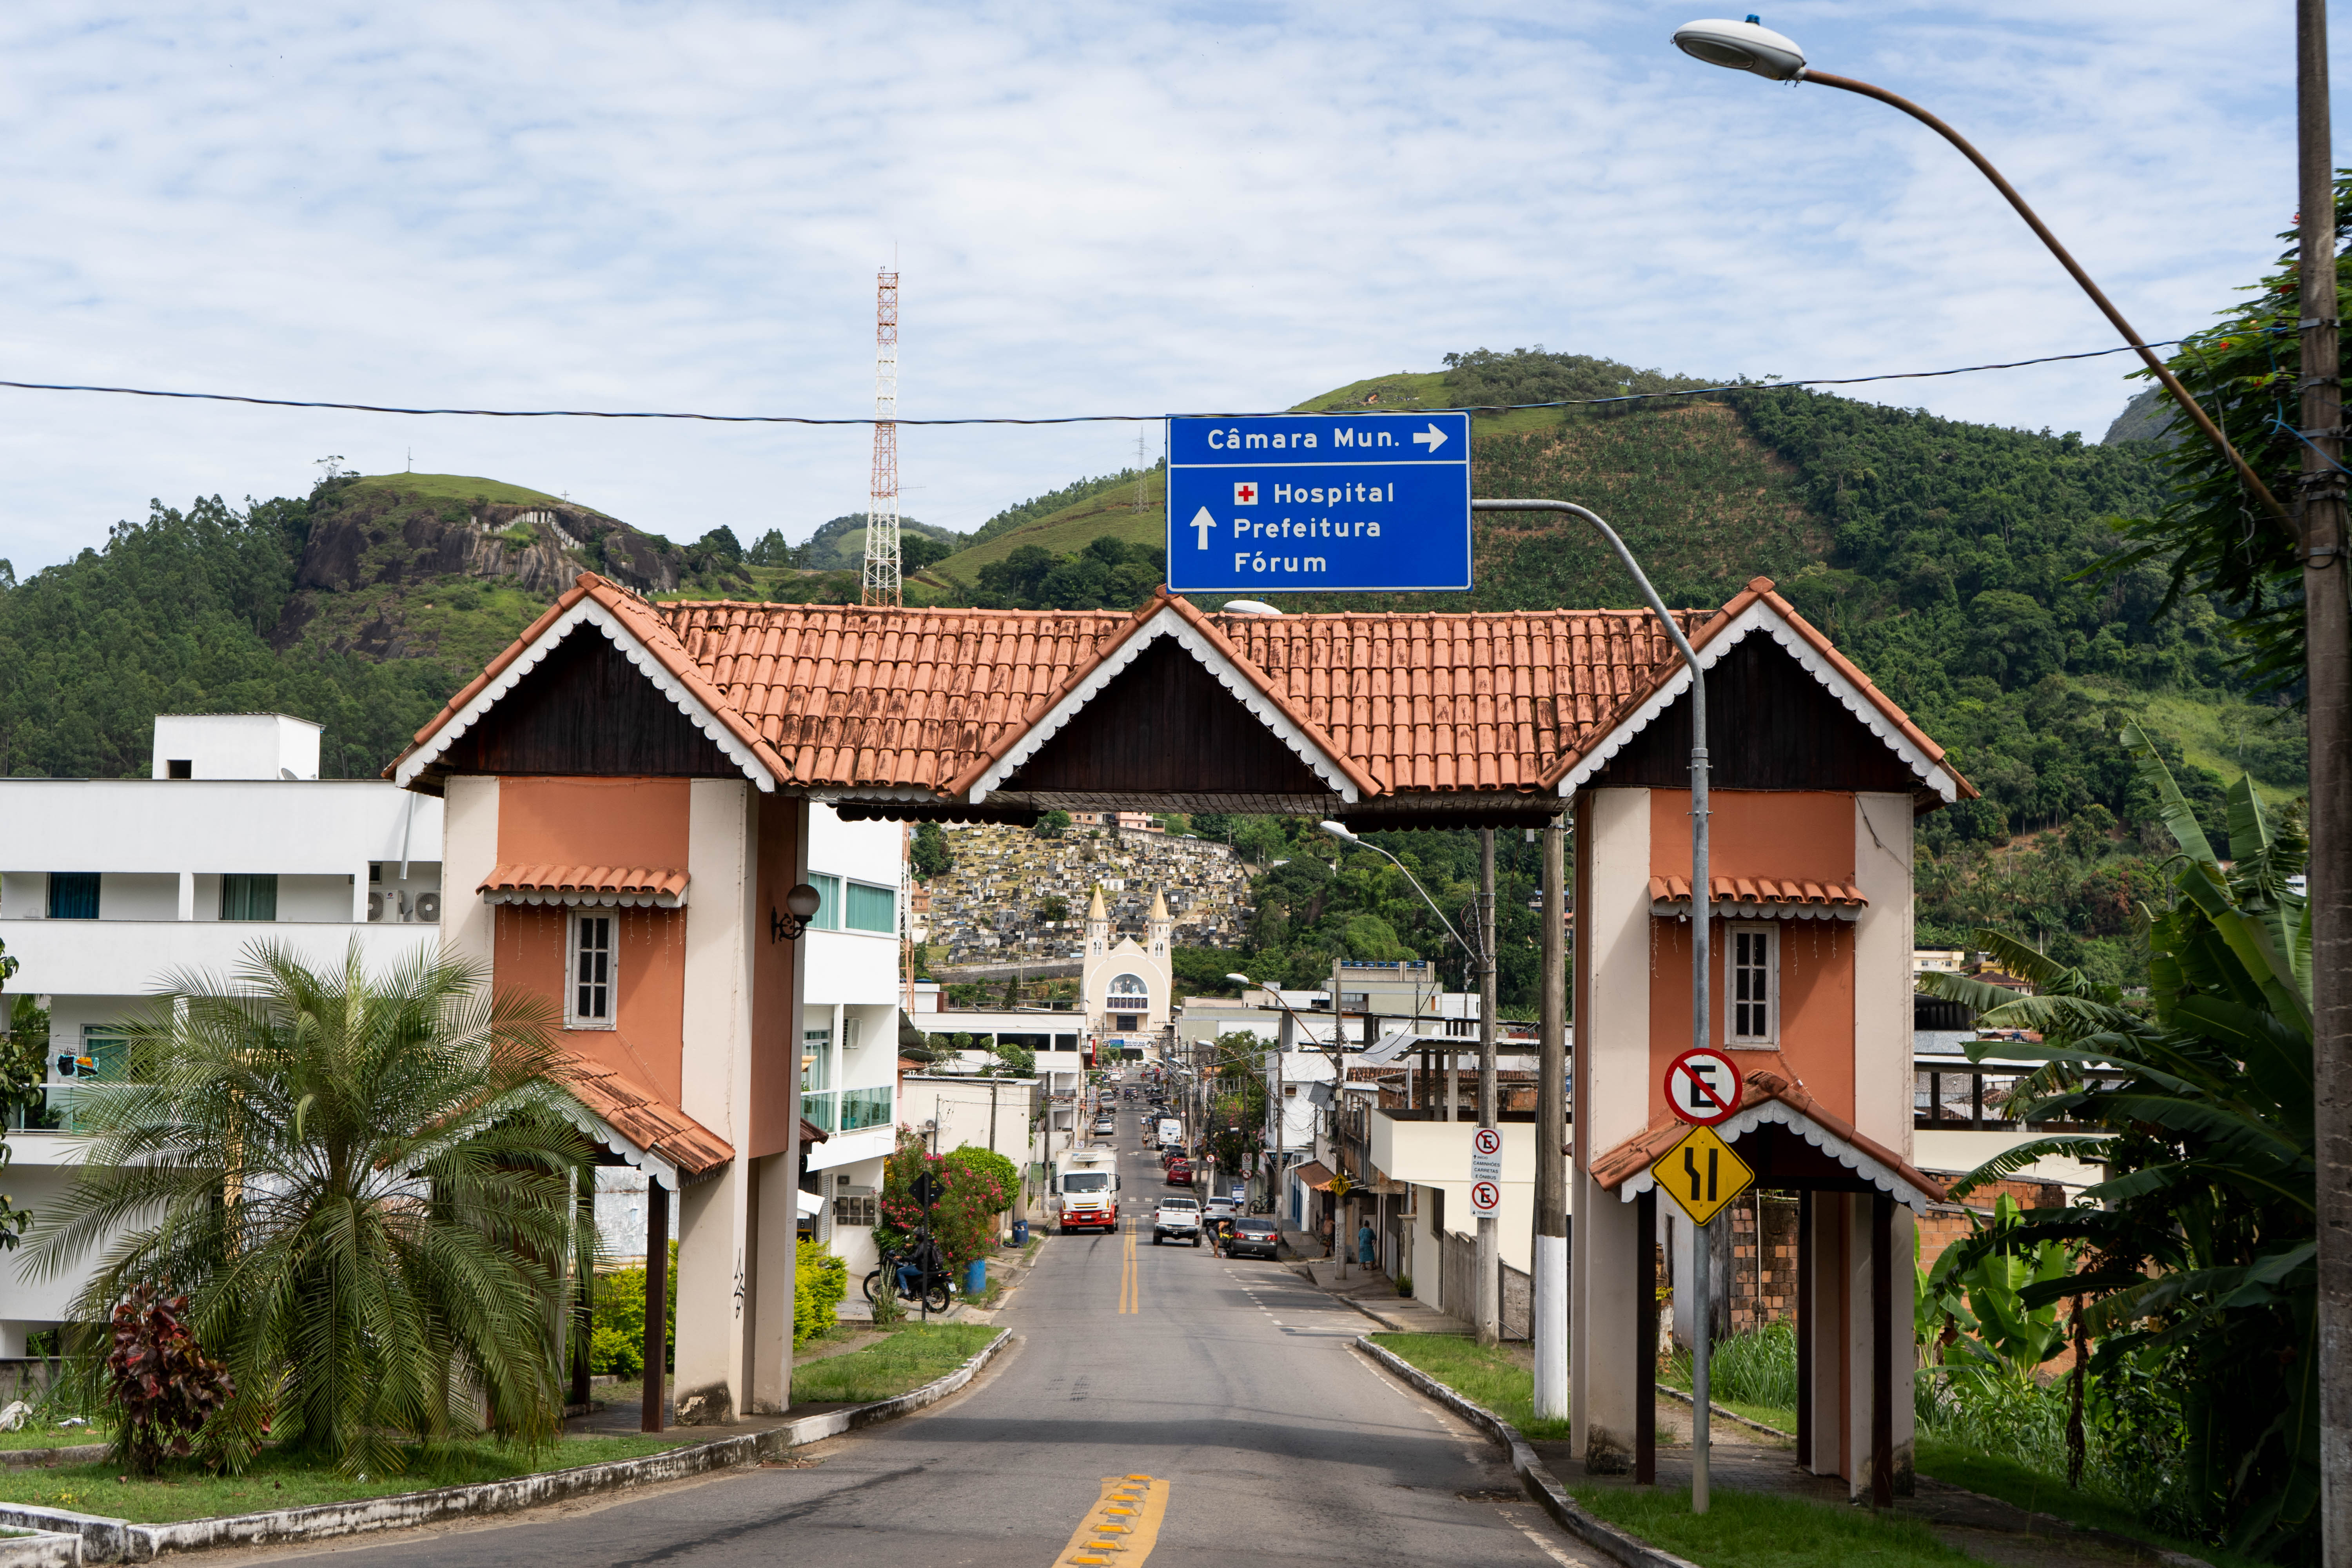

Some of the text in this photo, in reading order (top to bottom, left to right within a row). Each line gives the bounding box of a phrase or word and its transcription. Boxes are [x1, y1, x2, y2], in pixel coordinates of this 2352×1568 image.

[1209, 428, 1399, 449] Câmara Mun.
[1275, 483, 1393, 507] Hospital
[1234, 517, 1380, 538] Prefeitura
[1235, 551, 1326, 572] Fórum
[1691, 1065, 1716, 1107] E
[1483, 1135, 1492, 1149] E
[1481, 1188, 1490, 1203] E
